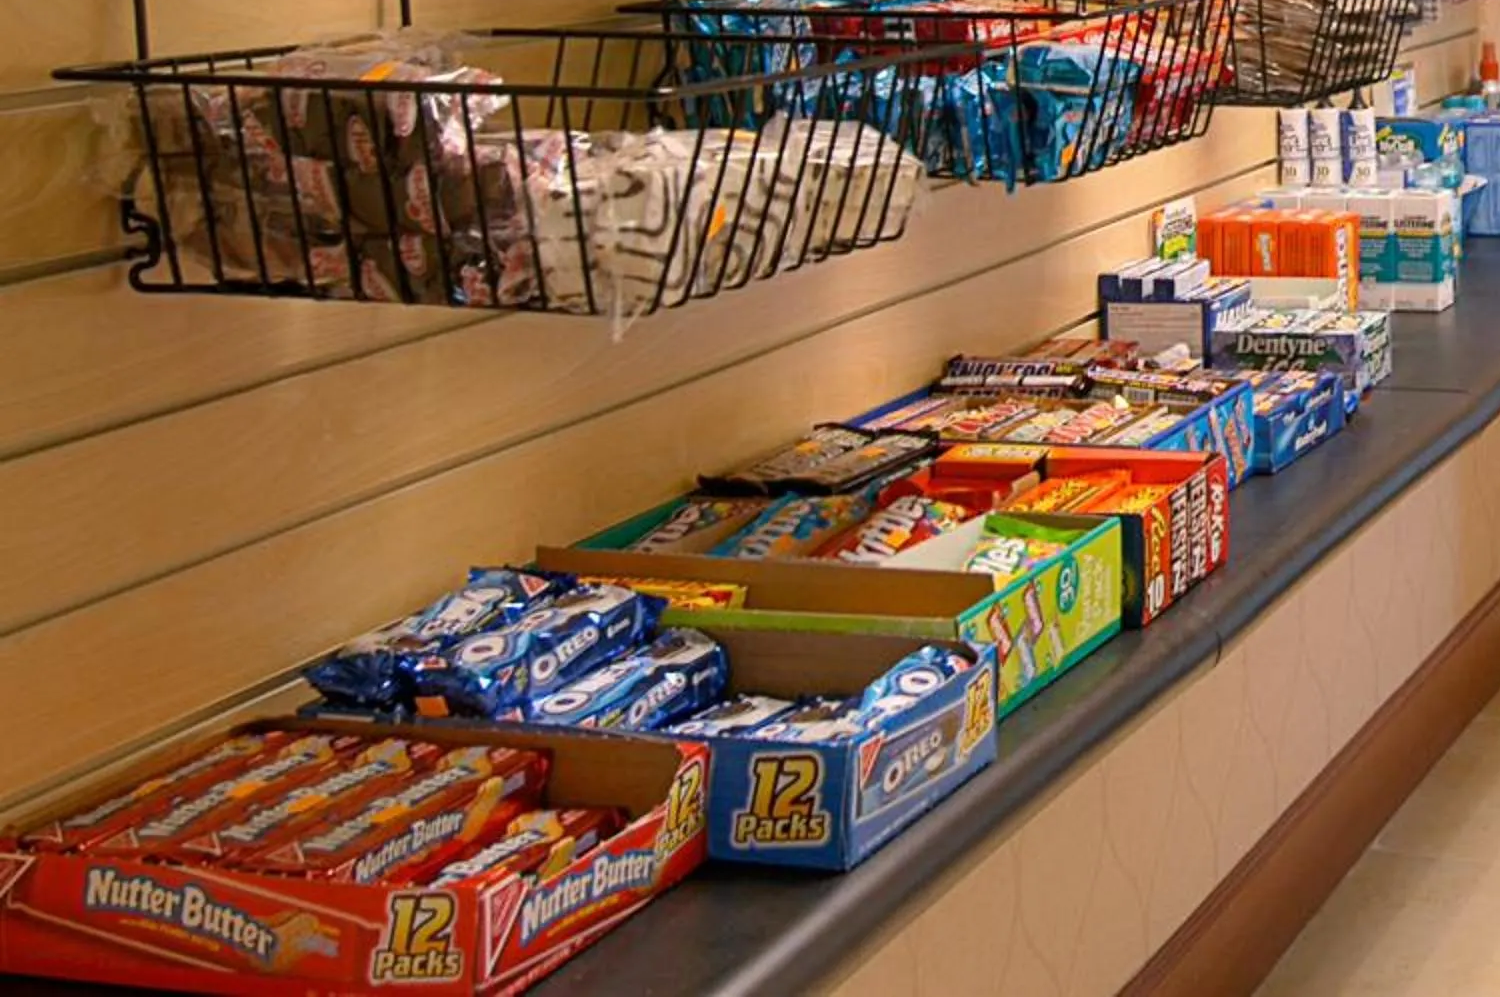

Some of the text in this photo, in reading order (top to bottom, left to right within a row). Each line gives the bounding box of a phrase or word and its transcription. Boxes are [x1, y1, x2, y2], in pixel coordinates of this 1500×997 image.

[1236, 333, 1327, 359] Dentyne
[532, 625, 600, 682] OREO
[752, 755, 819, 820] 12
[883, 731, 943, 793] OREO
[411, 810, 464, 847] Butter
[734, 809, 827, 845] Packs
[87, 867, 276, 957] Nutter Butter
[391, 893, 455, 953] 12
[520, 852, 656, 941] Nutter Butter
[373, 948, 461, 980] Packs
